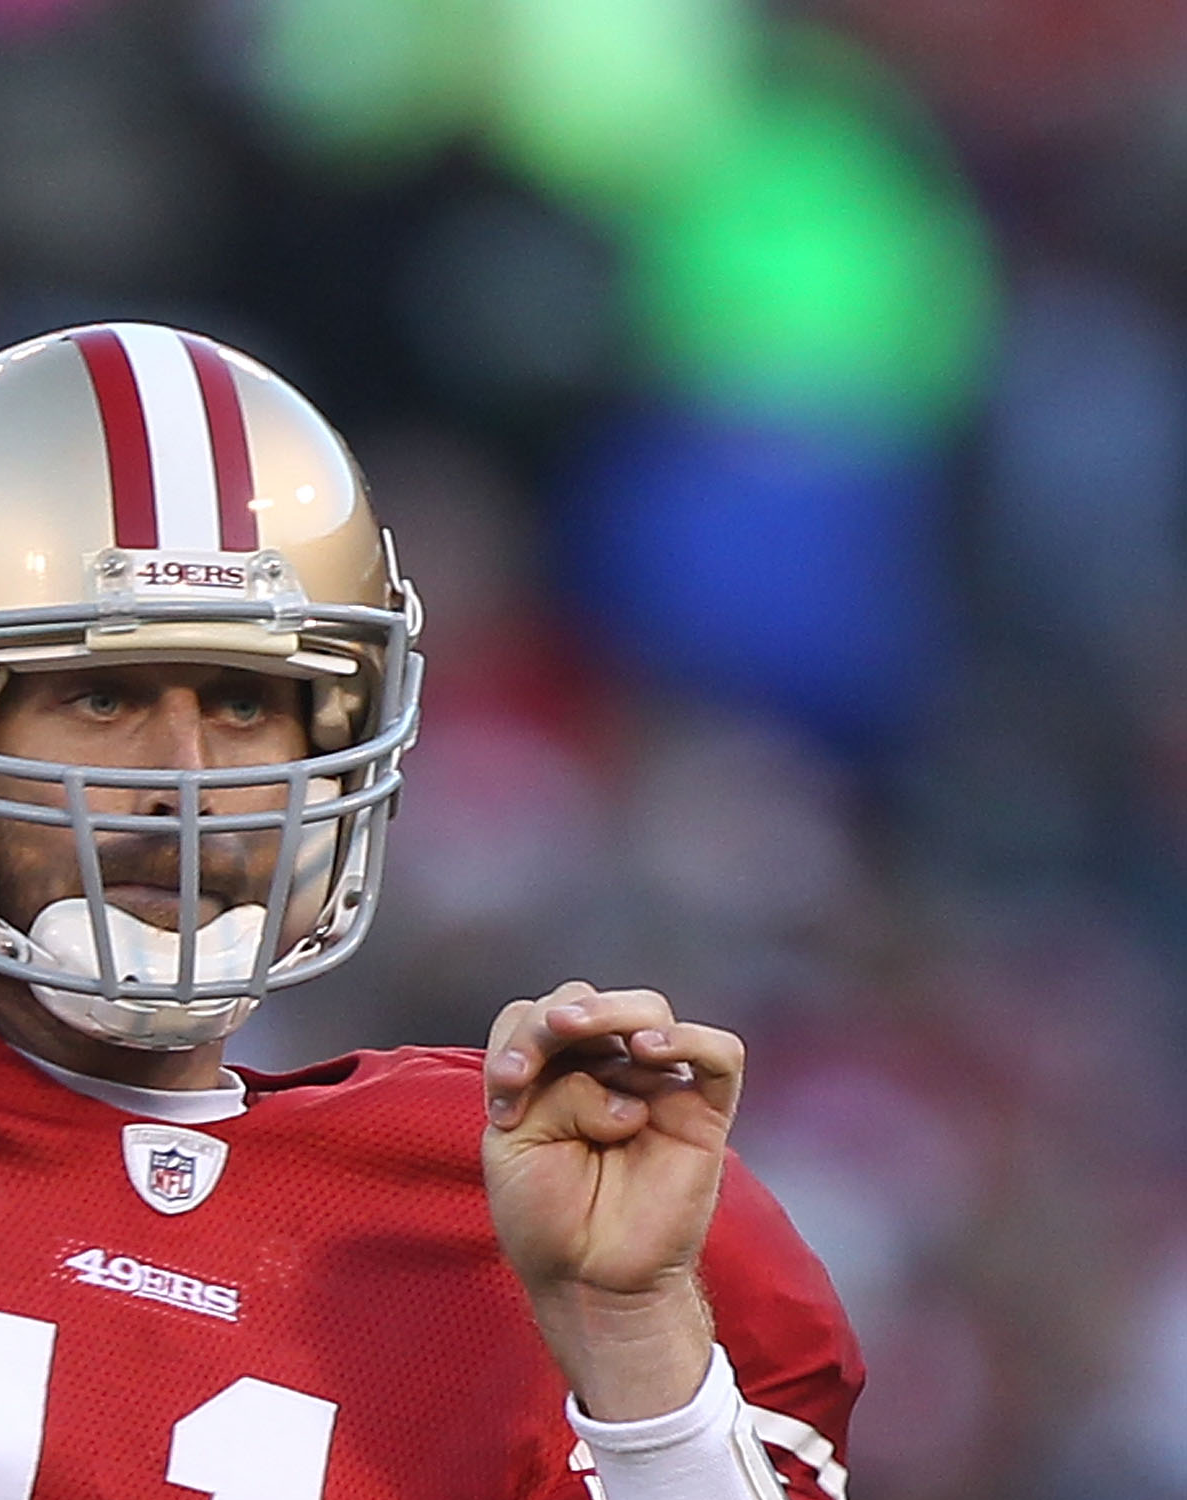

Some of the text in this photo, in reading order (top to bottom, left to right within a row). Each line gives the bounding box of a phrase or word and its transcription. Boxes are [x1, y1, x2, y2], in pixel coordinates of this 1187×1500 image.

[137, 561, 244, 589] 49ERS
[151, 1167, 193, 1198] NFL
[64, 1248, 239, 1322] 49ERS
